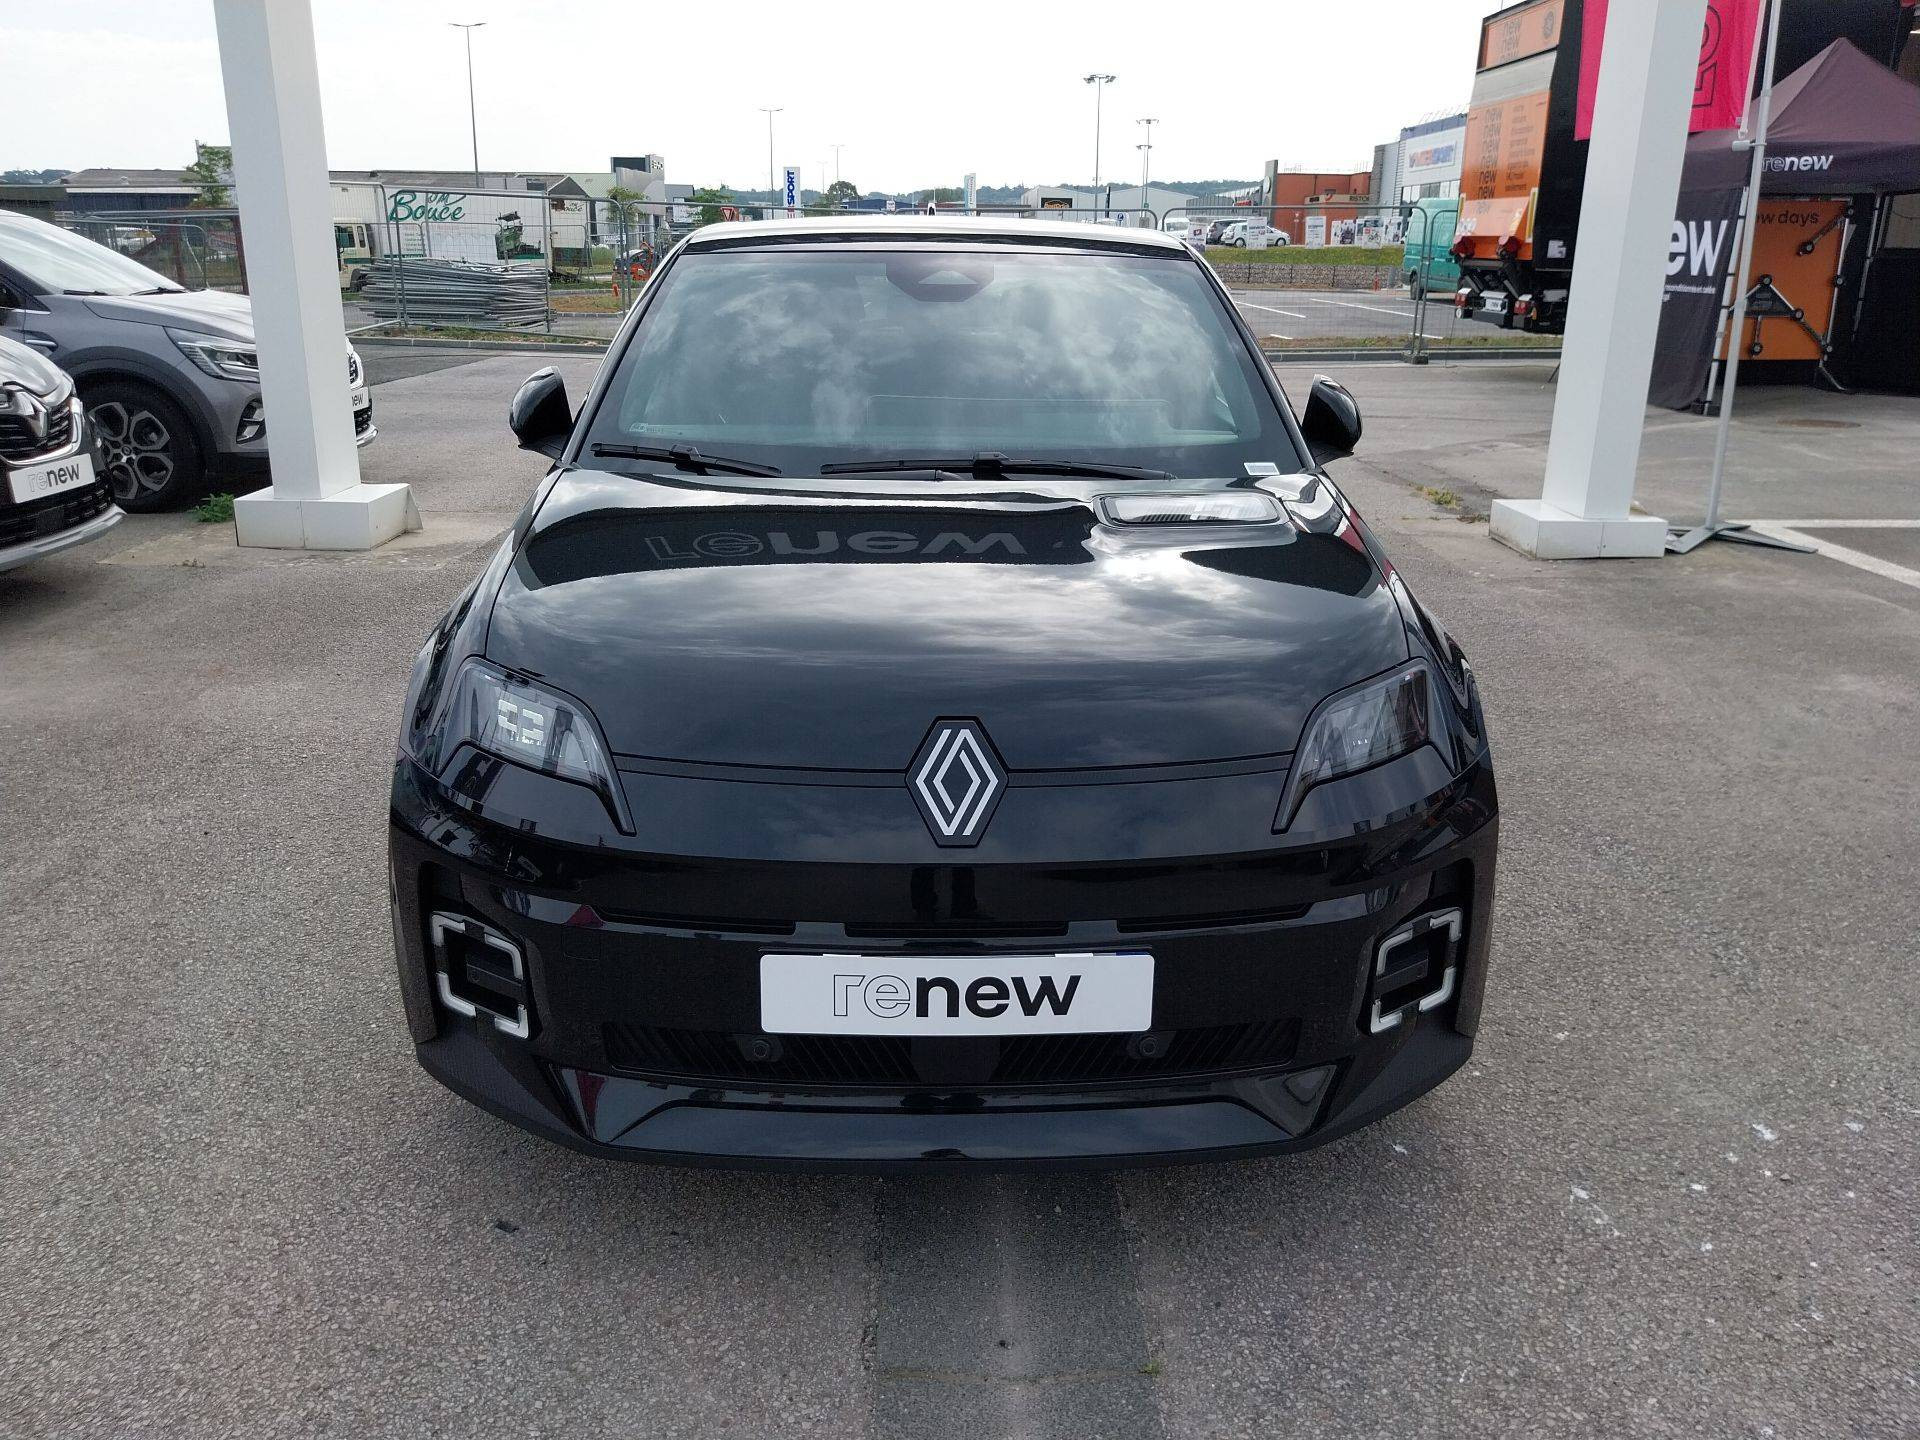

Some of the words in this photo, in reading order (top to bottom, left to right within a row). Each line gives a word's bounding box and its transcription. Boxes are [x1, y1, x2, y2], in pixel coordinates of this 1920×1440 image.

[1762, 155, 1834, 172] renew
[1778, 210, 1820, 227] days
[1667, 220, 1729, 276] ew
[28, 464, 81, 493] renew
[833, 974, 1082, 1018] renew
